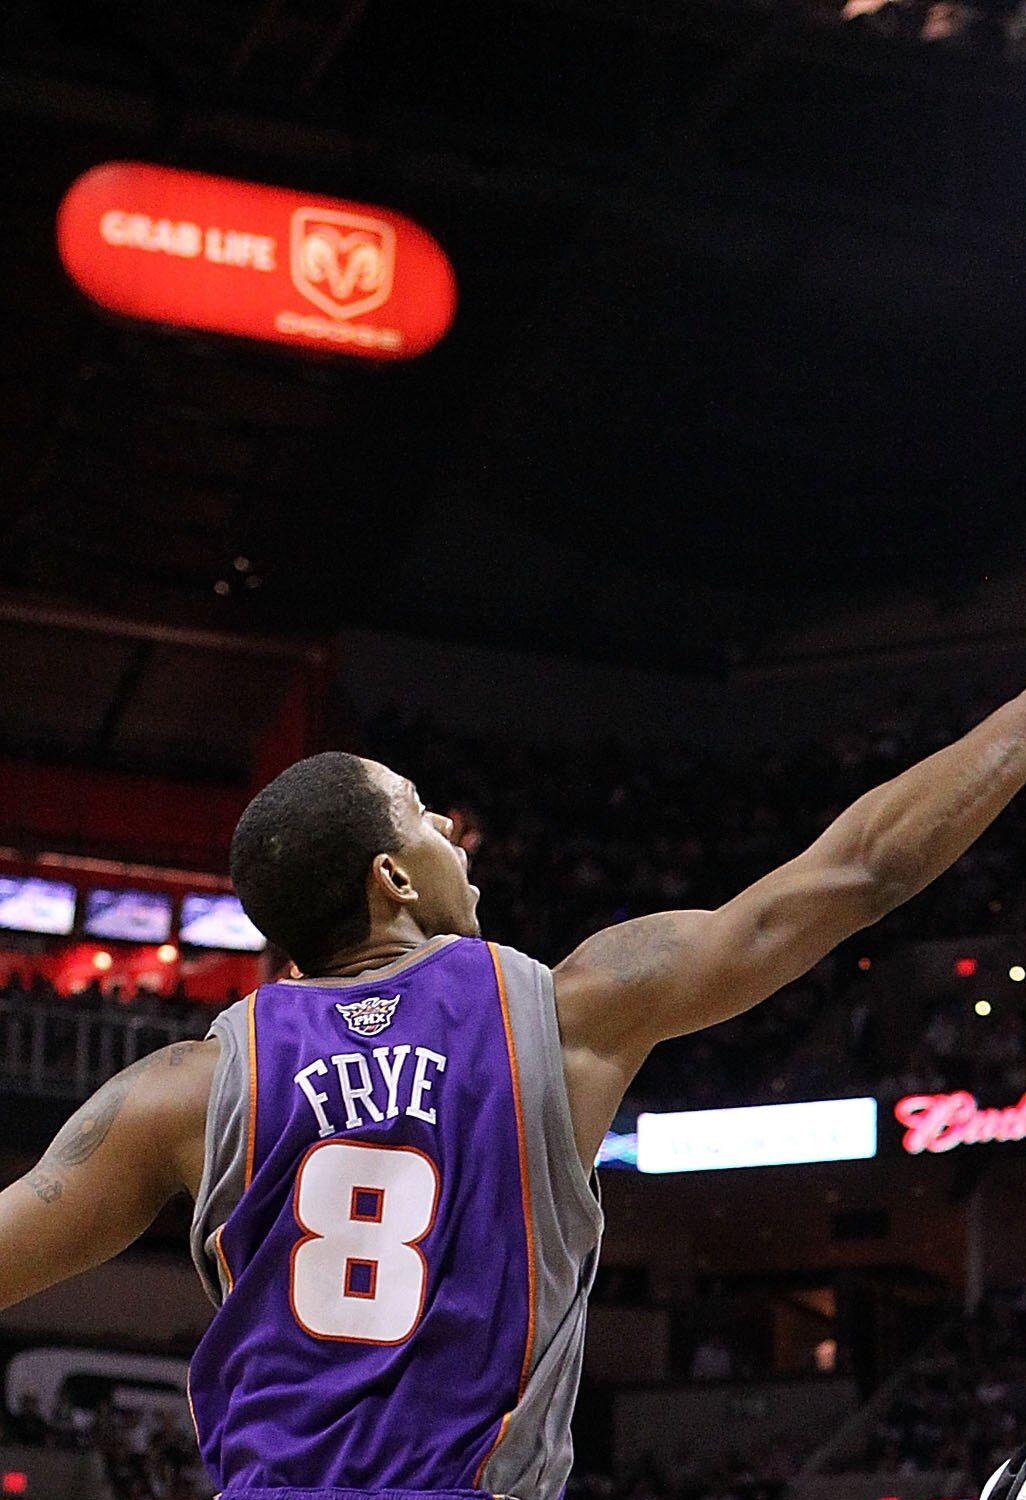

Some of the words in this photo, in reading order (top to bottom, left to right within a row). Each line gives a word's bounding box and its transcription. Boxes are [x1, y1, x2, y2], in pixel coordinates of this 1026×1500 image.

[101, 210, 200, 257] GRAB
[205, 227, 275, 271] LIFE
[353, 1013, 386, 1026] PHX
[294, 1044, 447, 1138] FRYE
[289, 1139, 440, 1346] 8
